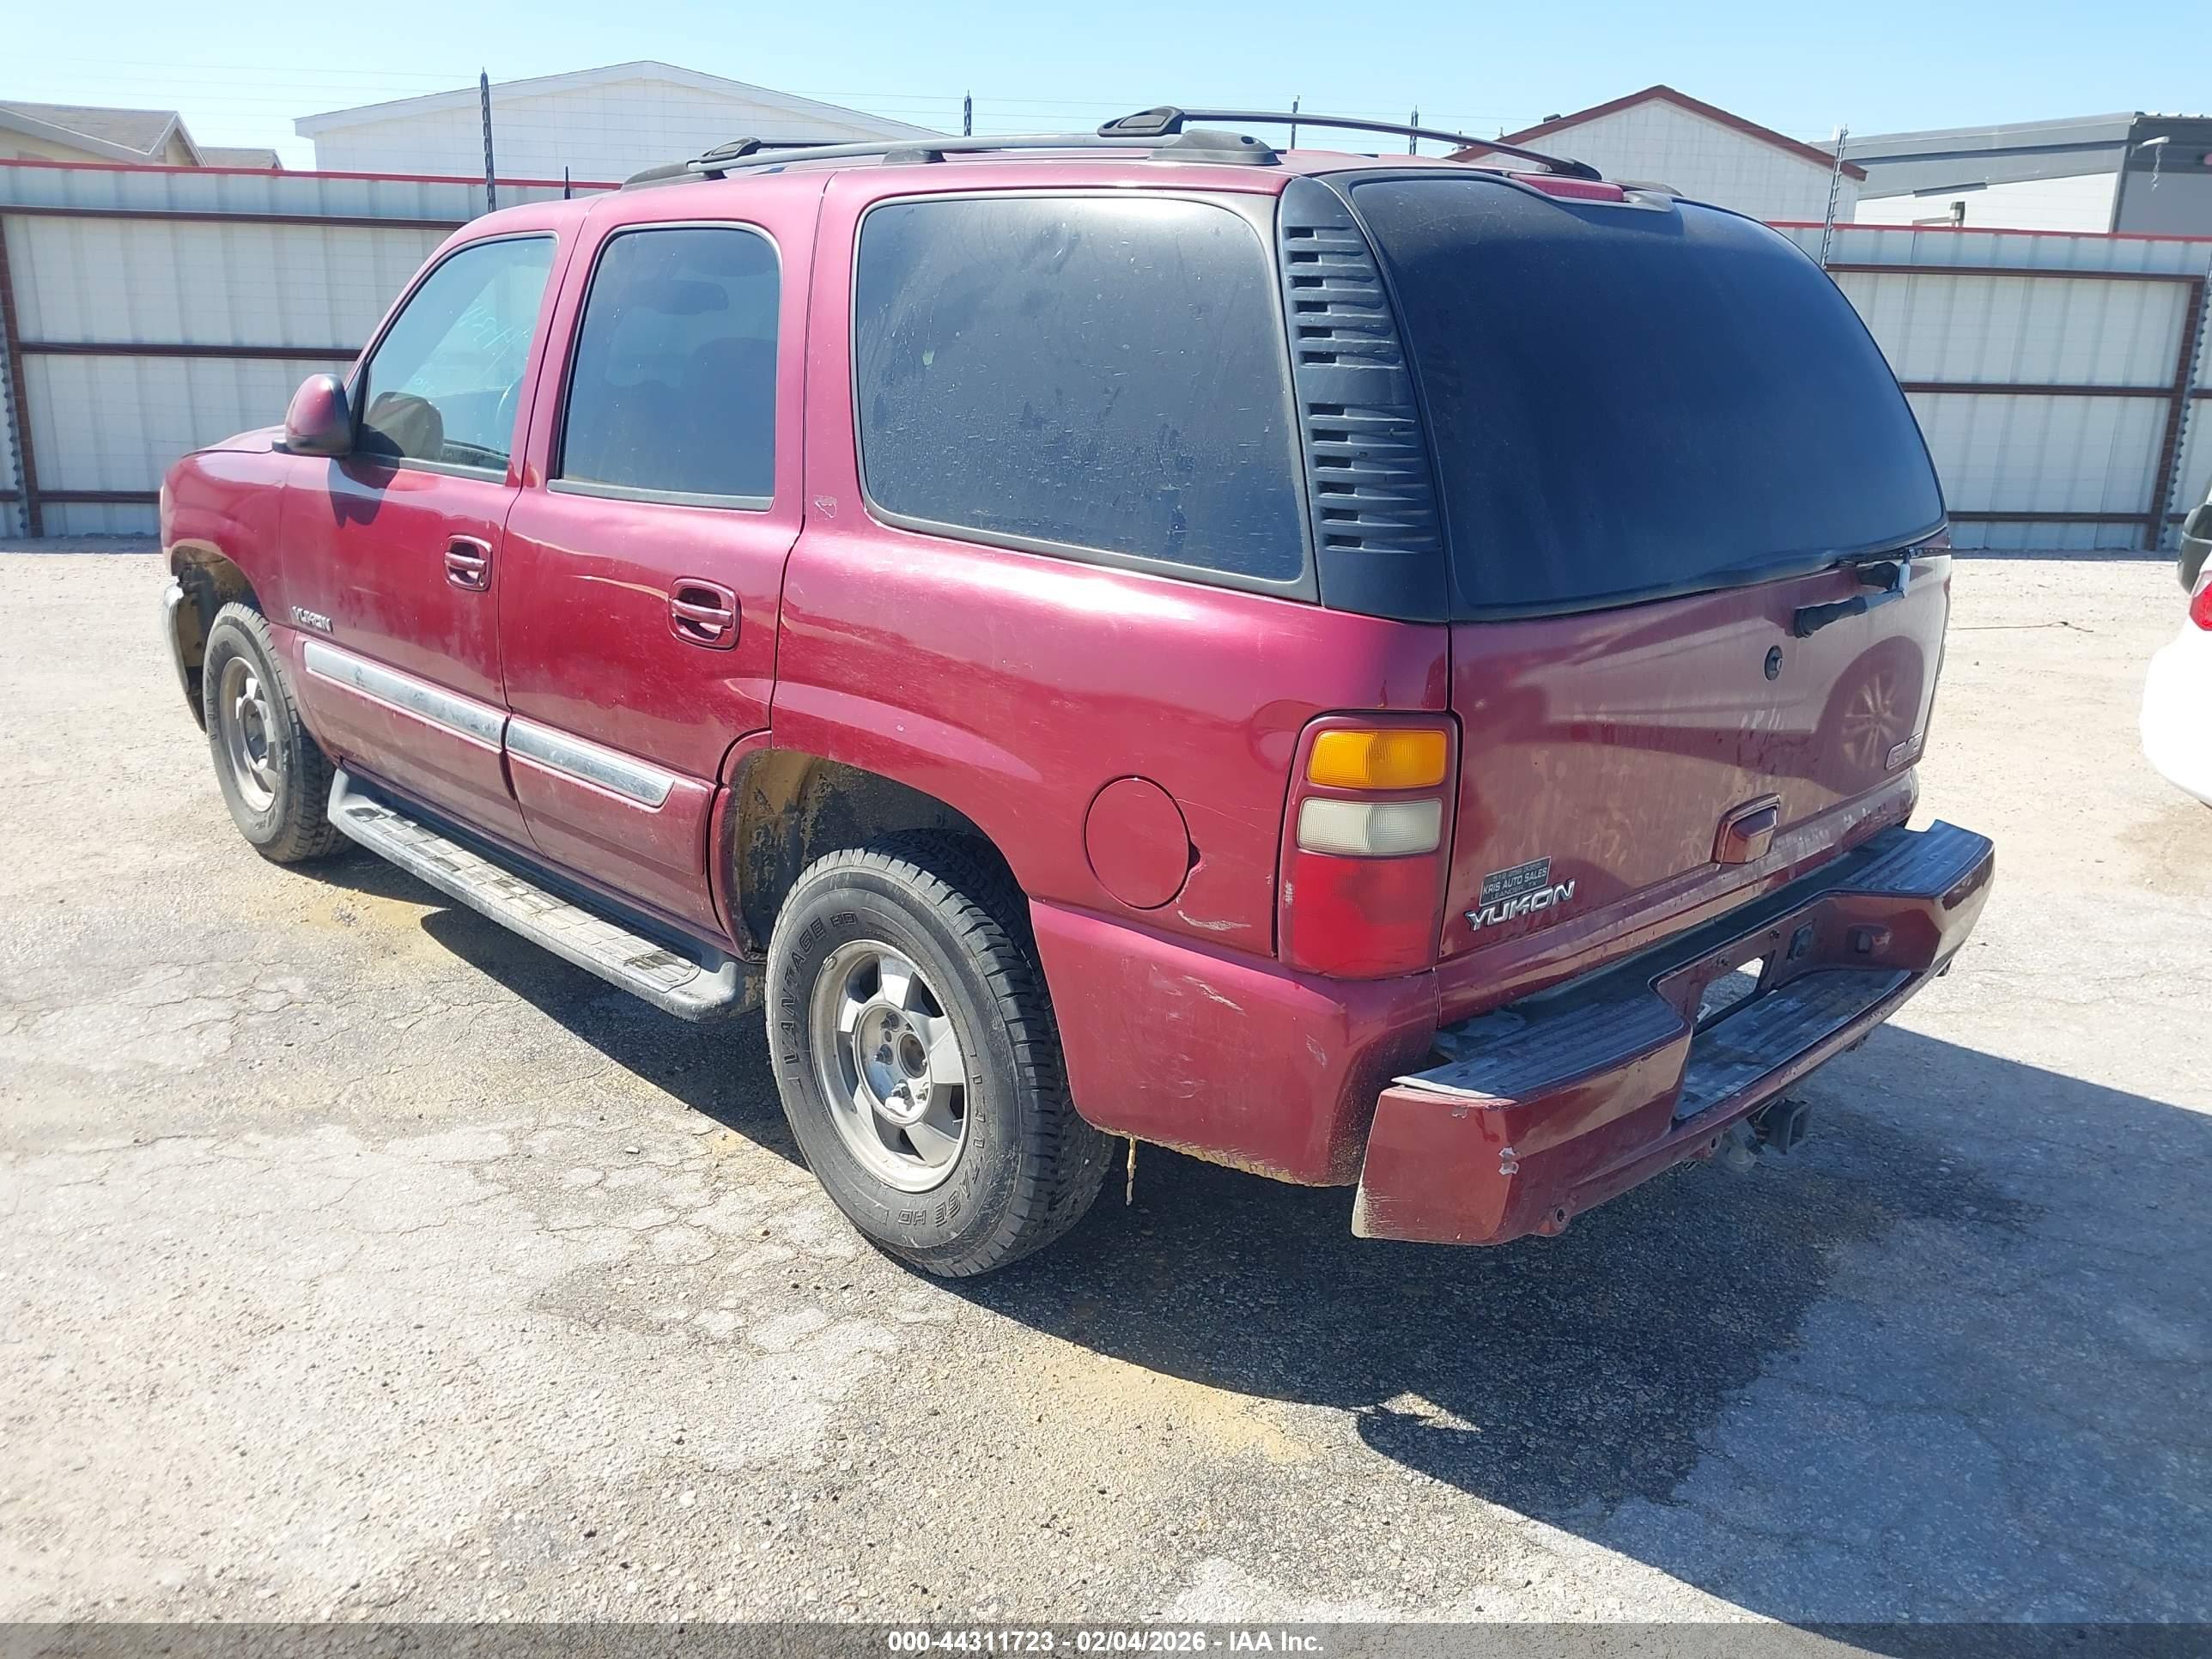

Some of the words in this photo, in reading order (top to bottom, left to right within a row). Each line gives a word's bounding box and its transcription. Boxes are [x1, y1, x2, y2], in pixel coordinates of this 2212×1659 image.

[291, 605, 332, 632] YUKON
[1483, 882, 1501, 896] KRIS
[1502, 875, 1523, 889] AUTO
[1524, 867, 1547, 883] SALES
[1464, 878, 1576, 931] YUKON
[781, 916, 827, 1065] VANTAGE
[830, 911, 858, 928] HD
